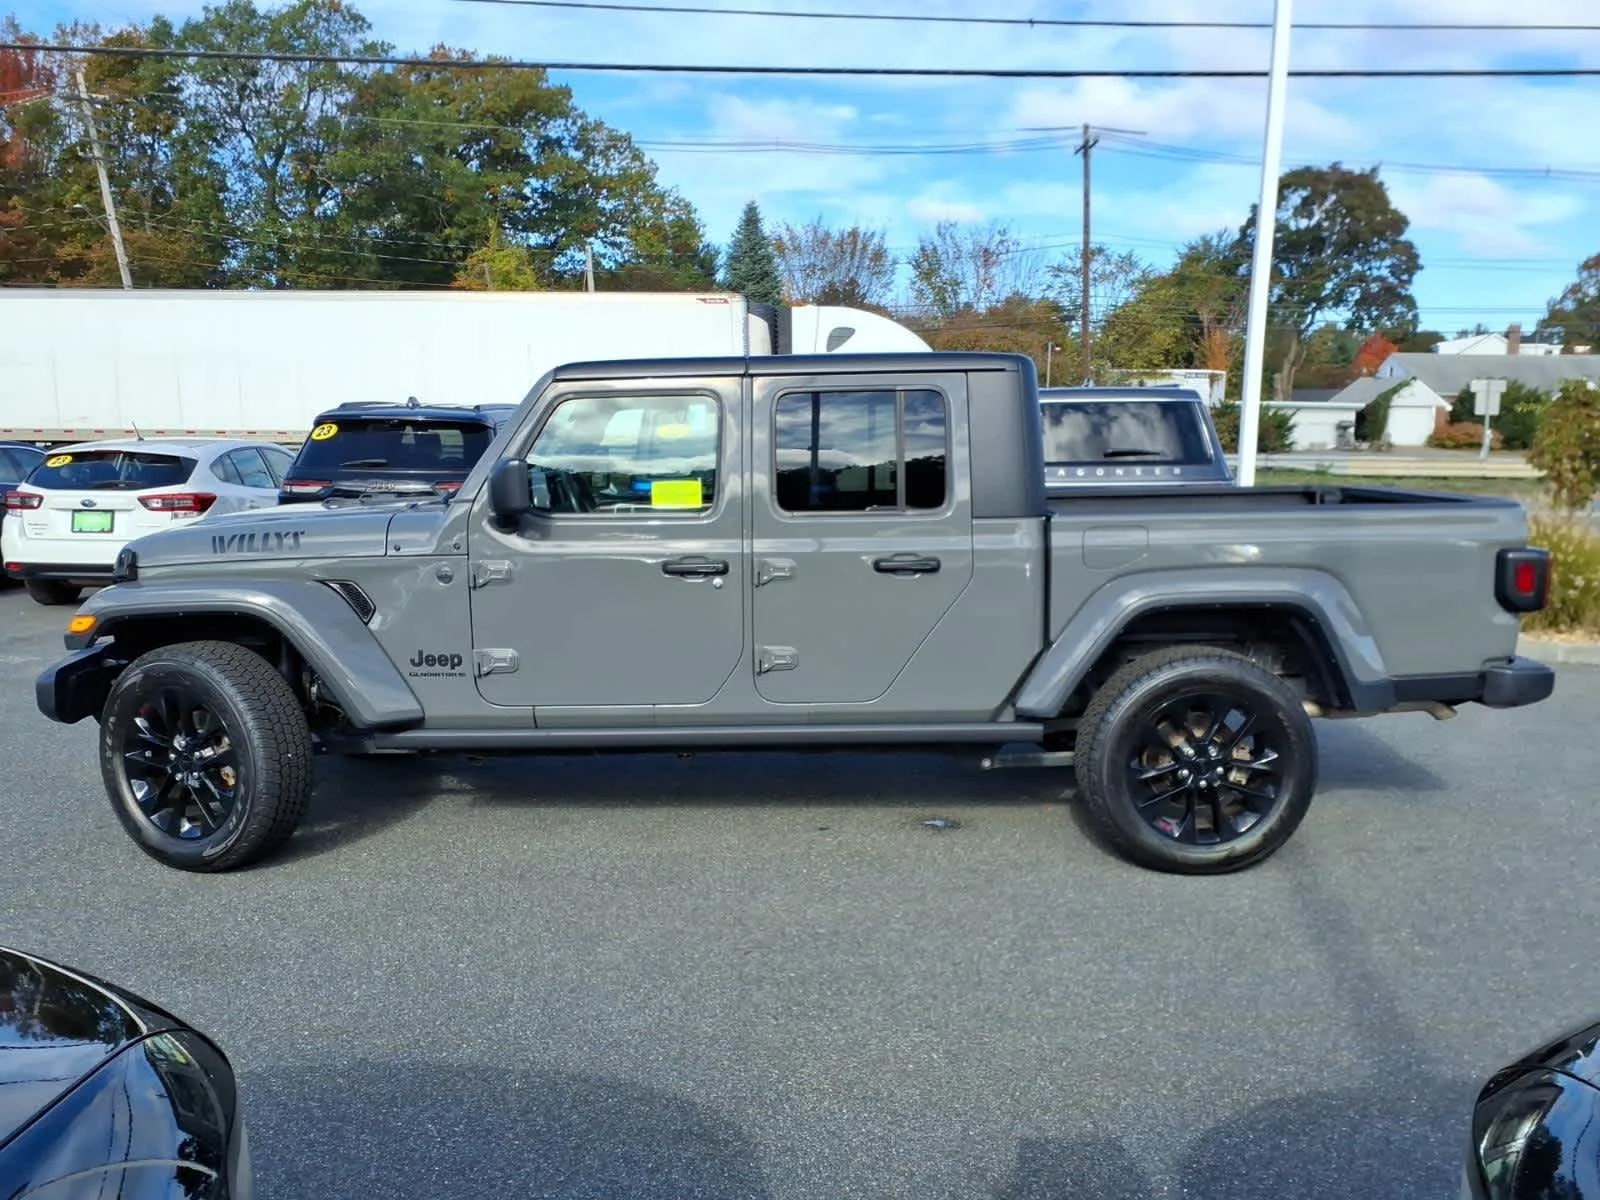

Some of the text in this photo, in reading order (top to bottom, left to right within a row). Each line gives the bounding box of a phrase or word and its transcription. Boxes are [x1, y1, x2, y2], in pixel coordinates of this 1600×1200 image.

[315, 425, 333, 437] 23
[1044, 467, 1182, 477] AGONEER
[212, 531, 305, 554] WILLYS
[409, 649, 463, 670] Jeep
